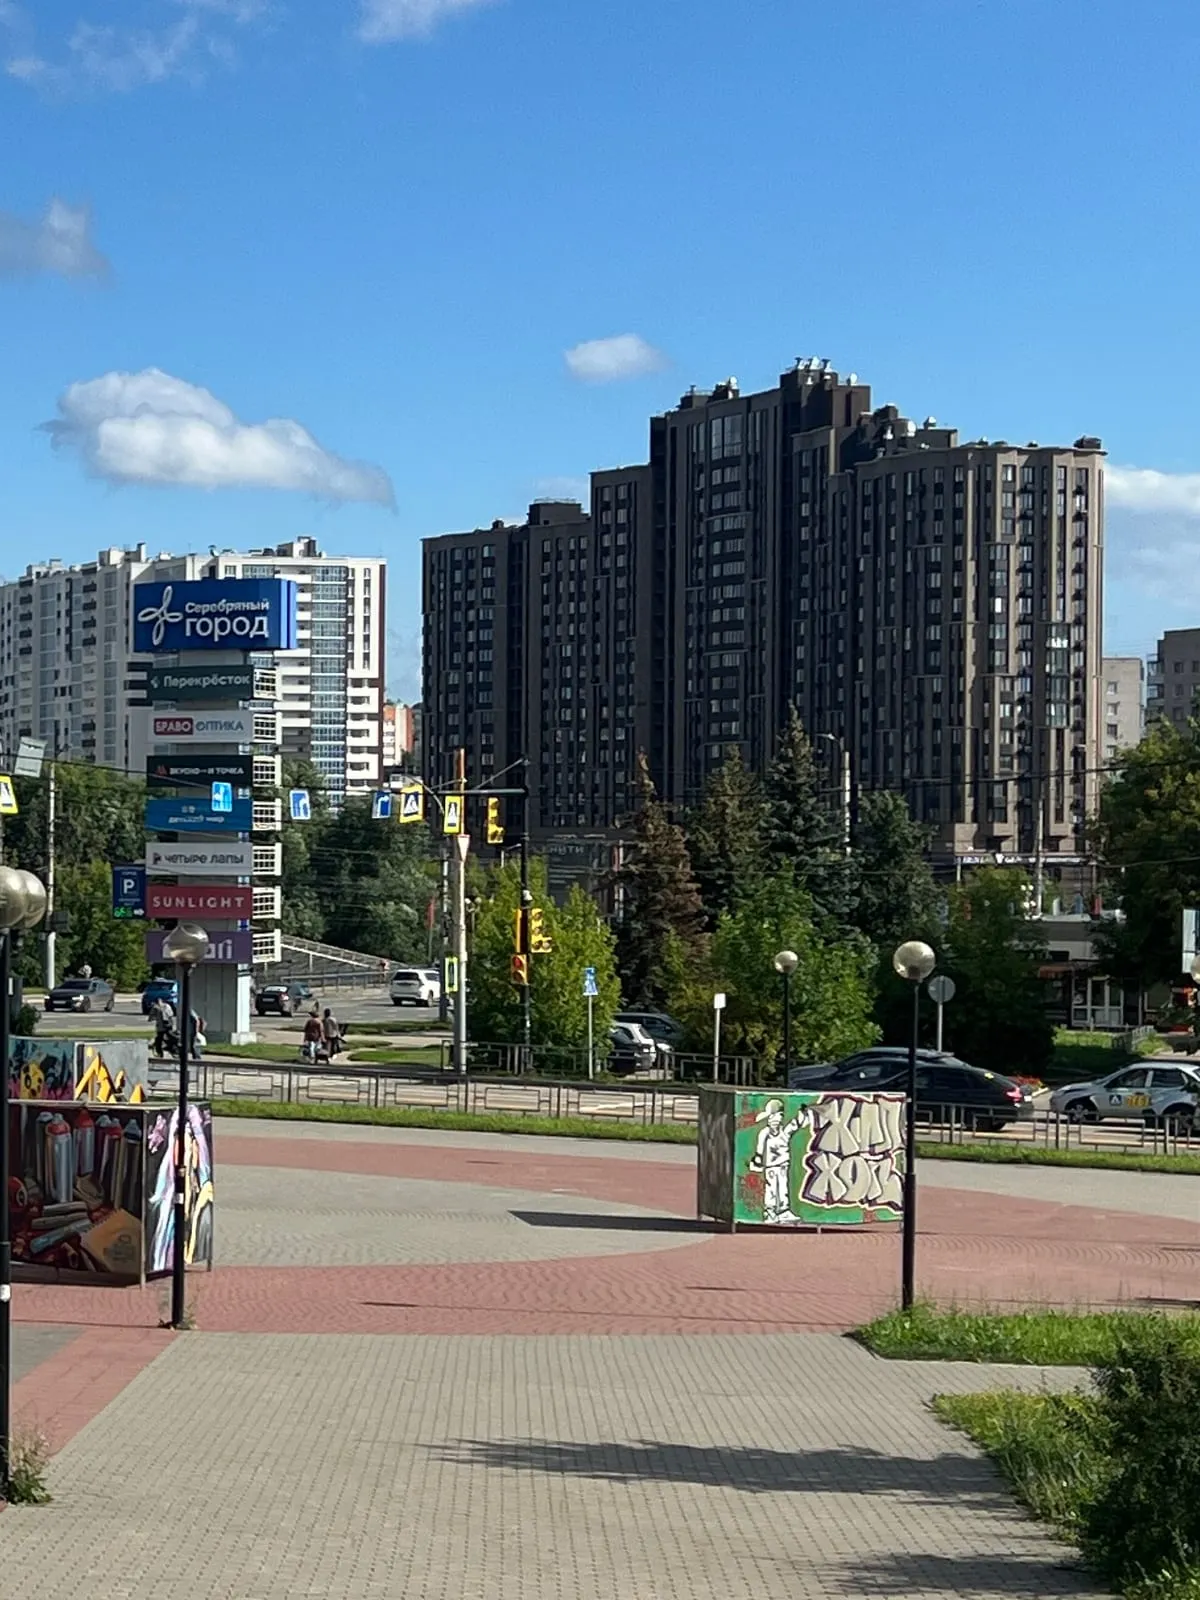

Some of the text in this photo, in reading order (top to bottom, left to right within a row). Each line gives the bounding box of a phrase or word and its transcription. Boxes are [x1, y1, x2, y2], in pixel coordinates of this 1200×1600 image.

[185, 599, 270, 615] Серебряный
[155, 719, 244, 733] БРАВО ОПТИКА
[123, 878, 135, 894] P
[152, 896, 245, 908] SUNLIGHT
